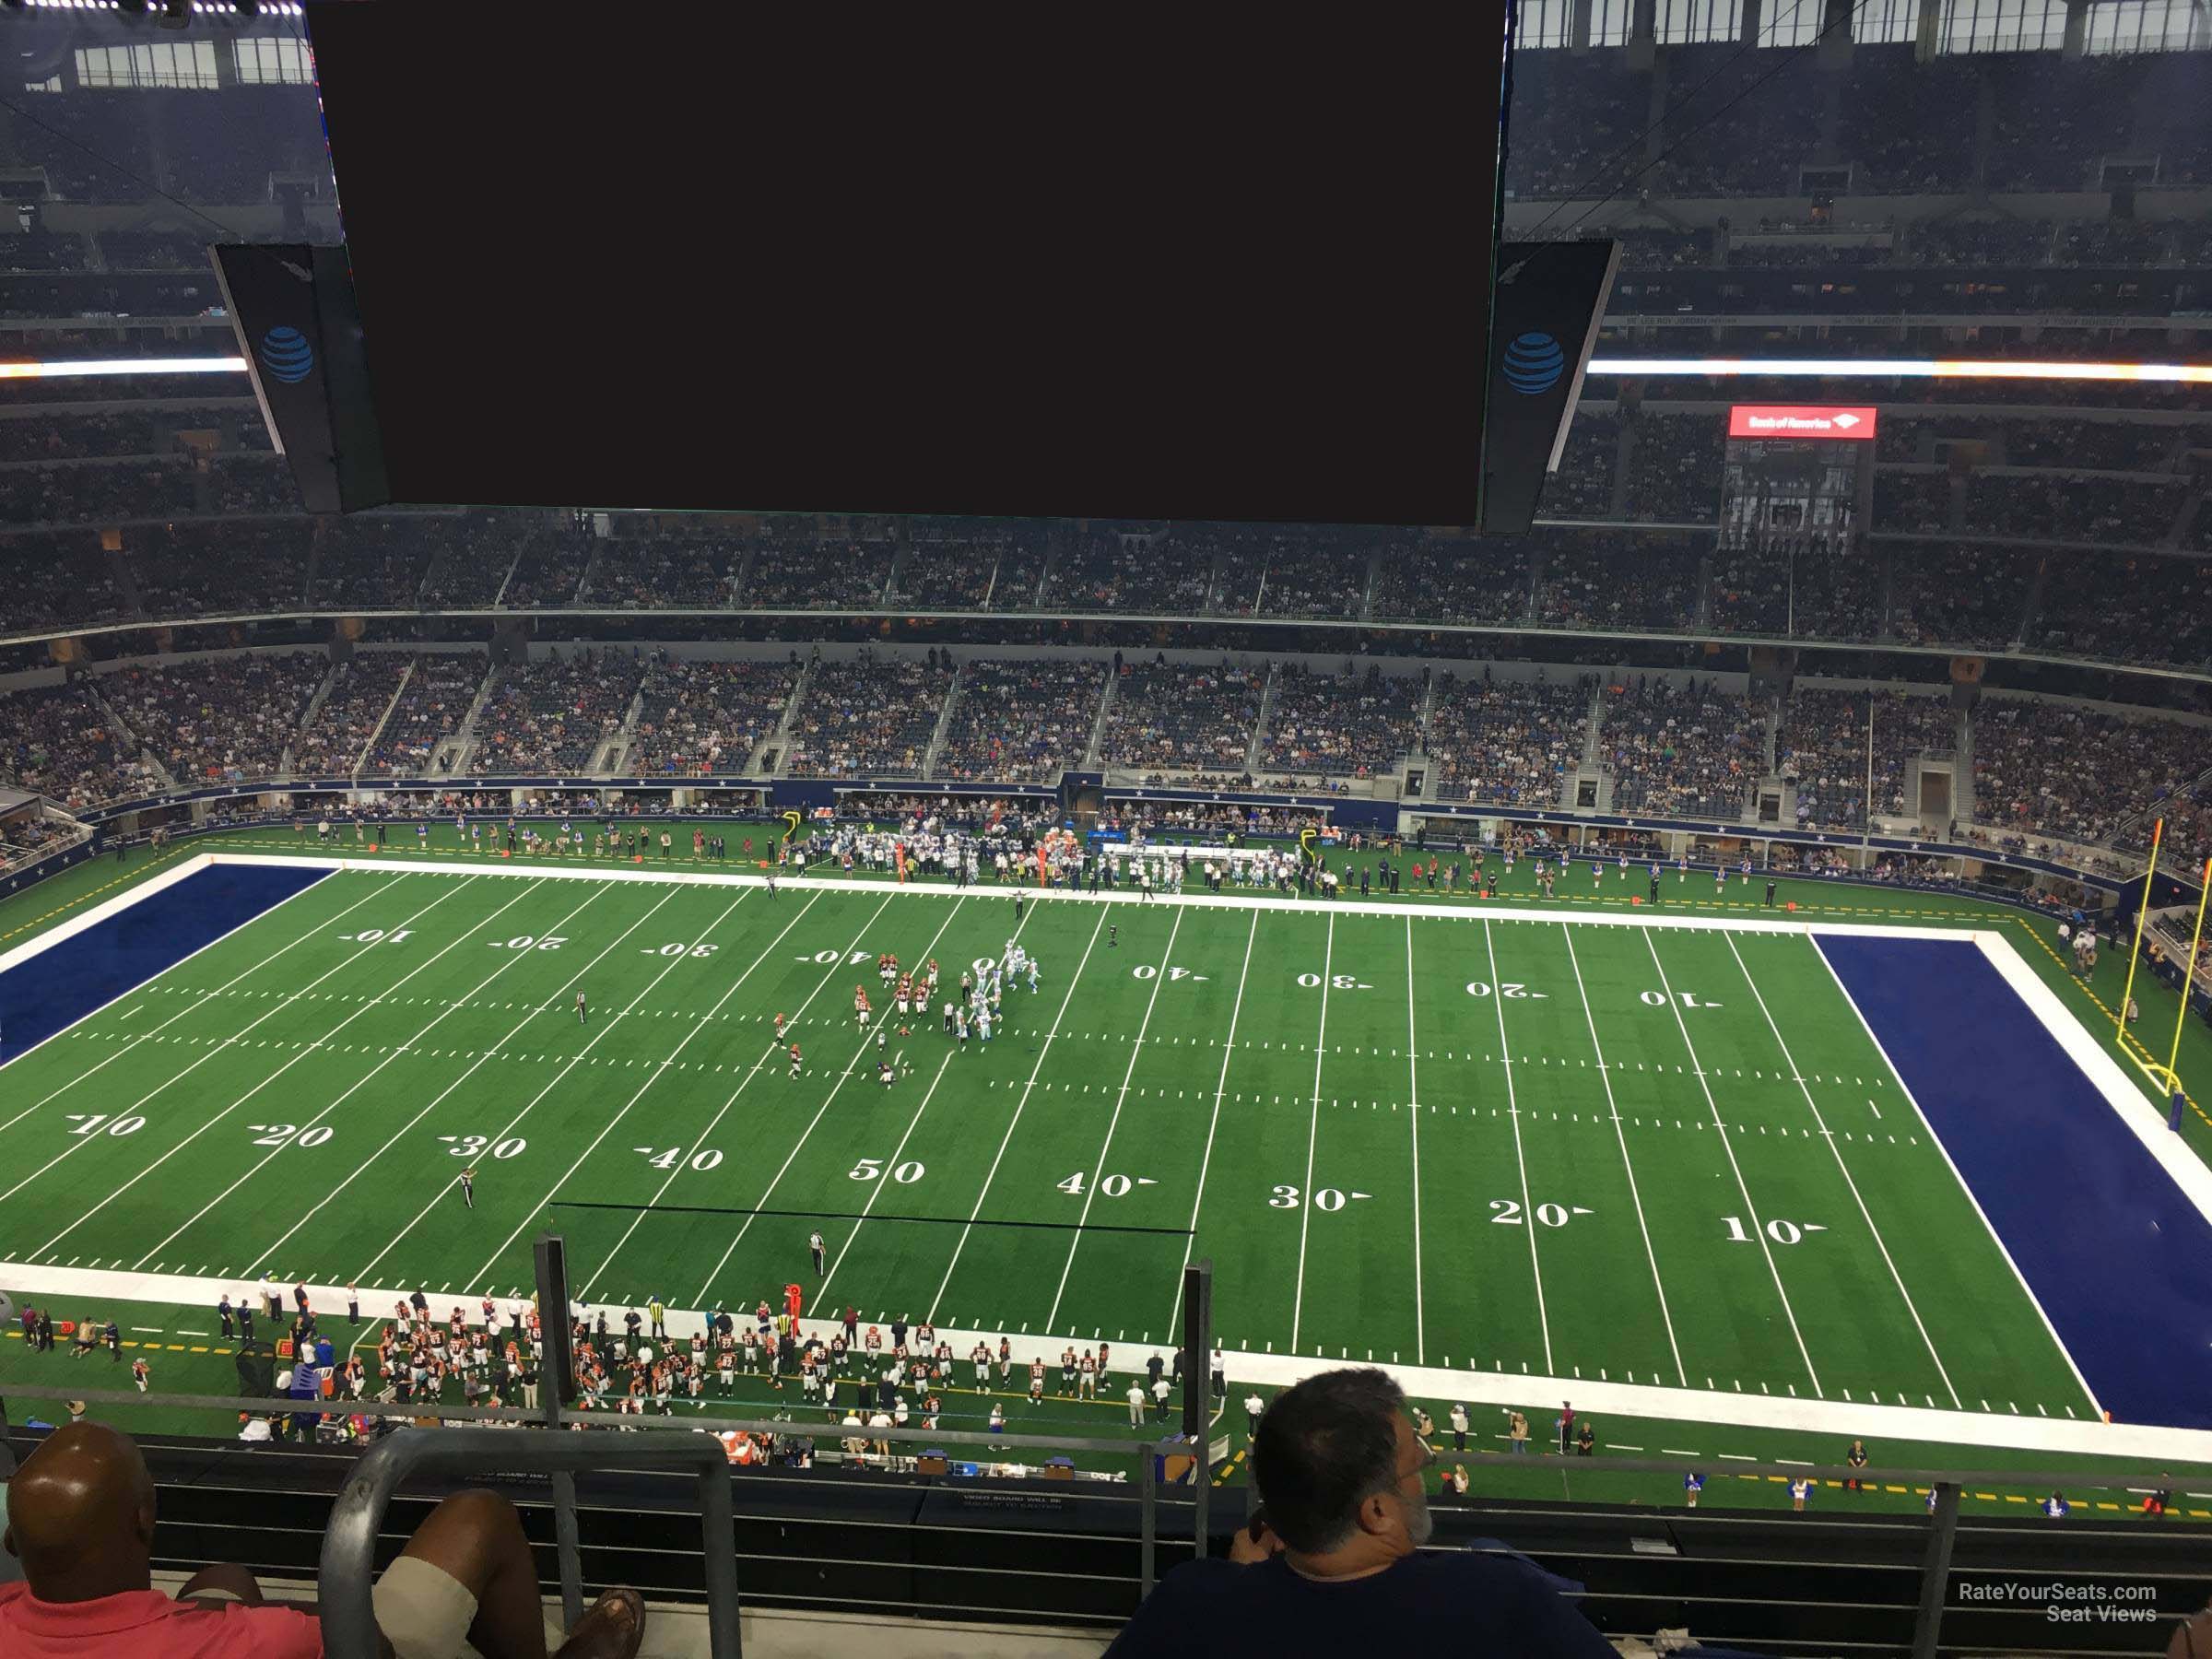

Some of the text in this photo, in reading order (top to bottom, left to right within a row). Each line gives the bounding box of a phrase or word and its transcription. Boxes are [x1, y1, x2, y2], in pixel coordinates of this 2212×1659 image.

[1749, 416, 1831, 429] Bank of America
[356, 928, 416, 943] 10
[507, 935, 569, 950] 20
[659, 943, 719, 958] 30
[814, 950, 873, 965] 40
[1133, 966, 1192, 981] 40
[1297, 973, 1356, 989] 30
[1466, 982, 1527, 998] 20
[1640, 991, 1701, 1007] 10
[67, 1114, 147, 1135] 10
[253, 1124, 334, 1147] 20
[450, 1135, 526, 1159] 30
[648, 1147, 724, 1171] 40
[848, 1159, 925, 1183] 50
[1056, 1171, 1132, 1196] 40
[1268, 1185, 1346, 1212] 30
[1489, 1200, 1570, 1228] 20
[1721, 1216, 1802, 1244] 10
